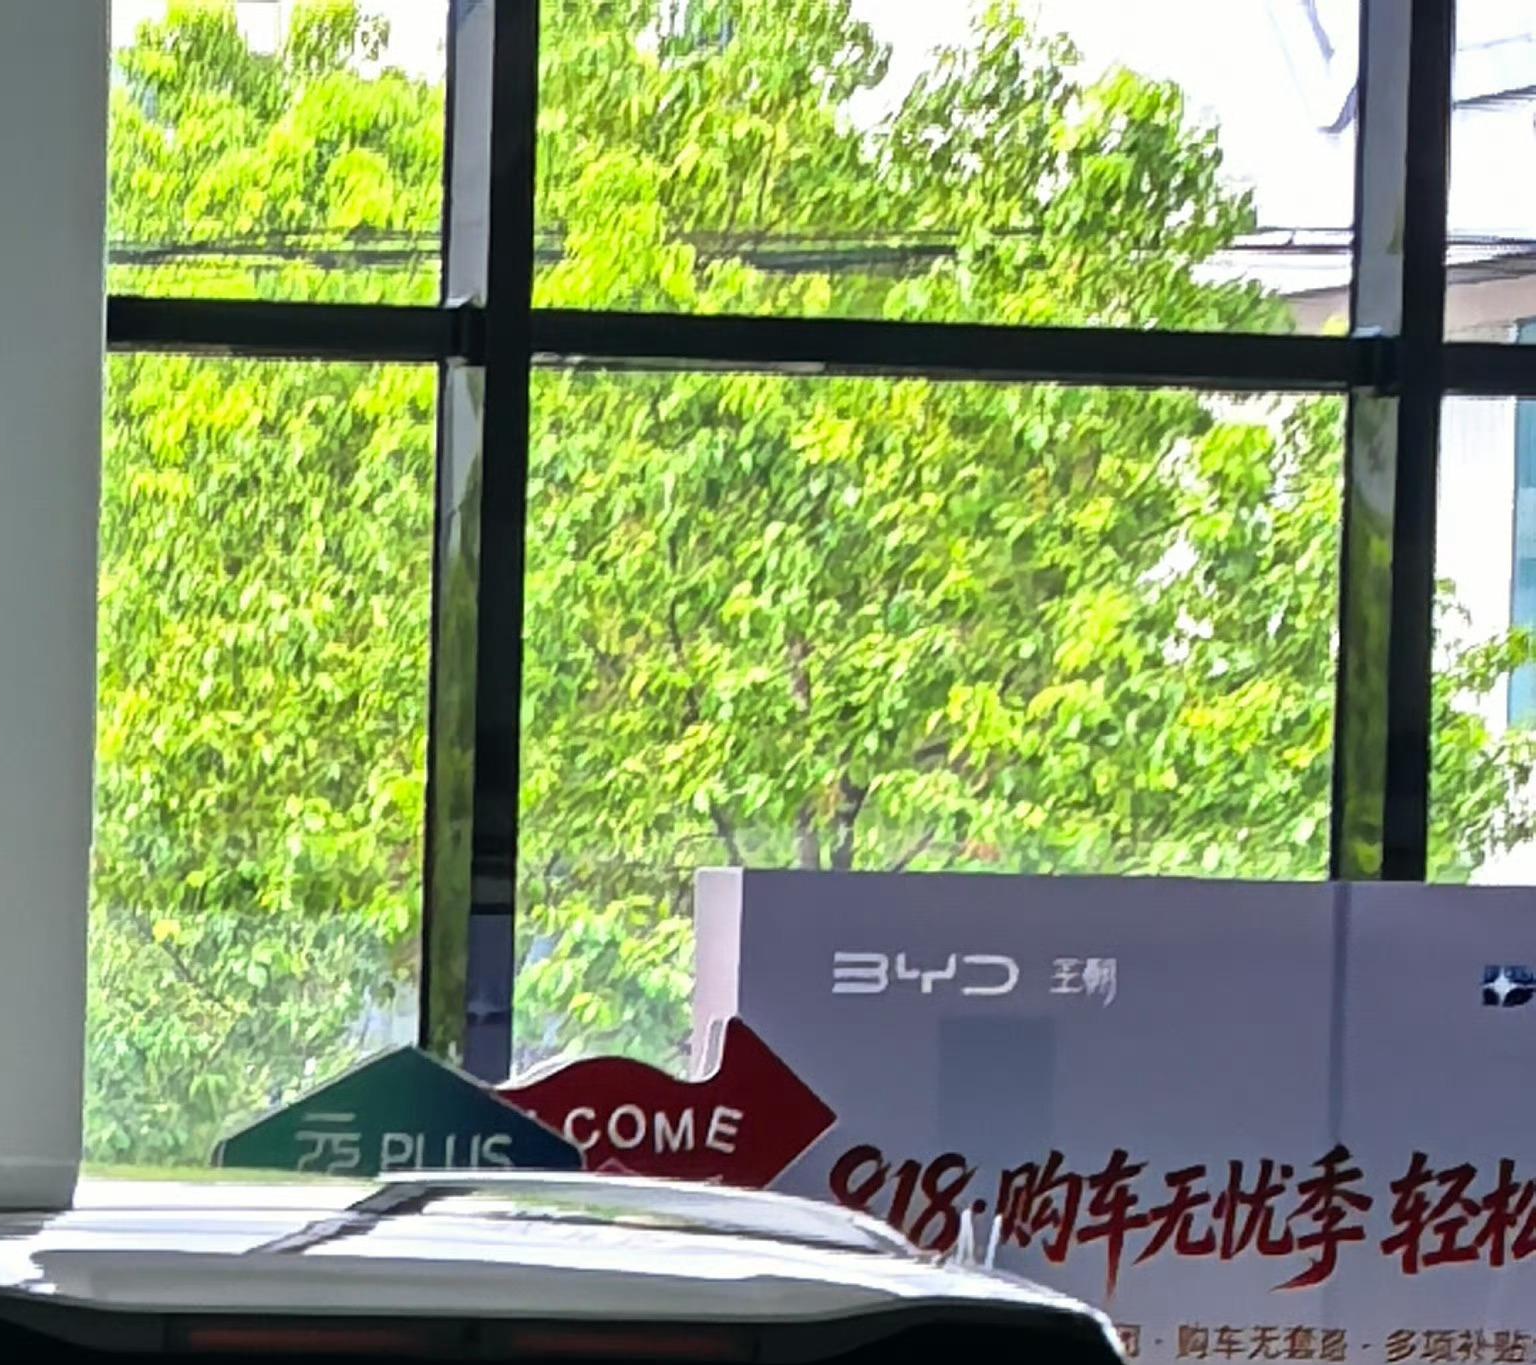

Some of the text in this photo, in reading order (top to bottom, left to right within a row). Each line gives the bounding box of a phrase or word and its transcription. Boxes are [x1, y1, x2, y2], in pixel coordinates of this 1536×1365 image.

[831, 951, 1020, 995] BYD
[564, 1104, 746, 1154] COME
[1385, 1329, 1536, 1363] 多项补贴
